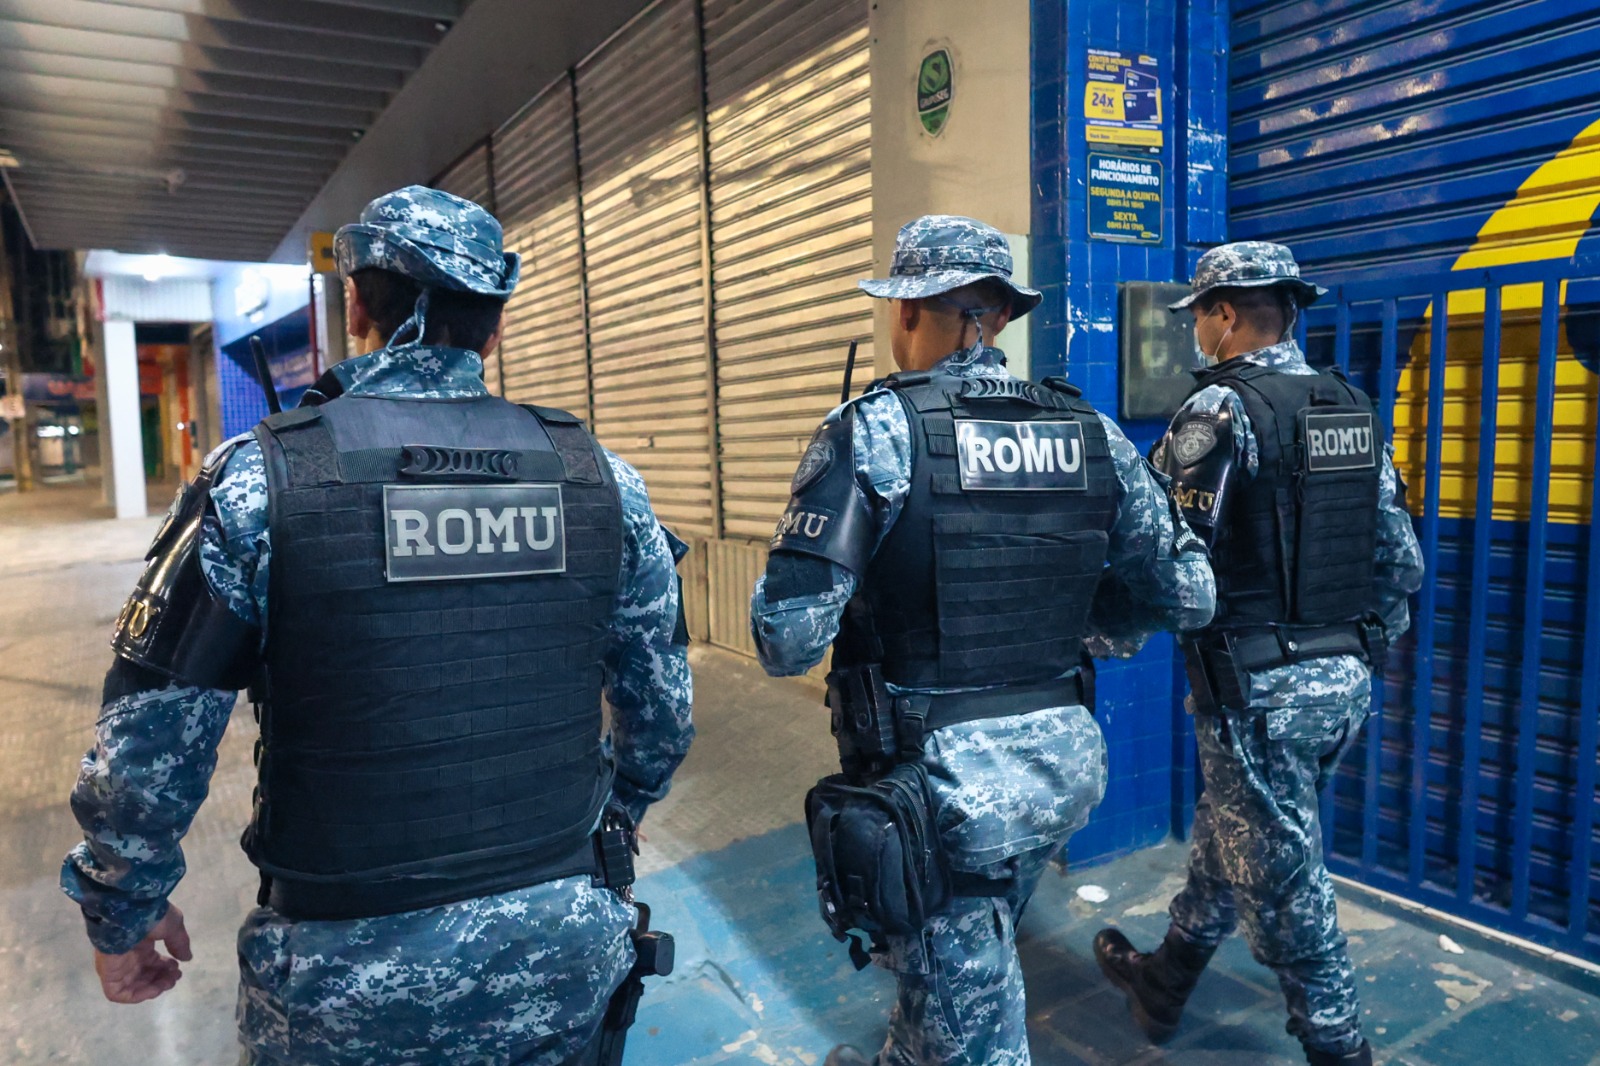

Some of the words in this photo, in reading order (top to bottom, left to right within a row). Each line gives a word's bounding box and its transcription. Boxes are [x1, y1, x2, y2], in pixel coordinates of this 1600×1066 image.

[1099, 159, 1140, 173] HORÁRIOS
[1141, 164, 1152, 174] DE
[1091, 169, 1159, 186] FUNCIONAMENTO
[1091, 187, 1125, 198] SEGUNDA
[1127, 190, 1132, 199] A
[1133, 191, 1160, 202] QUINTA
[1113, 211, 1137, 222] SEXTA
[1308, 427, 1370, 457] ROMU
[965, 437, 1080, 473] ROMU
[390, 507, 558, 557] ROMU
